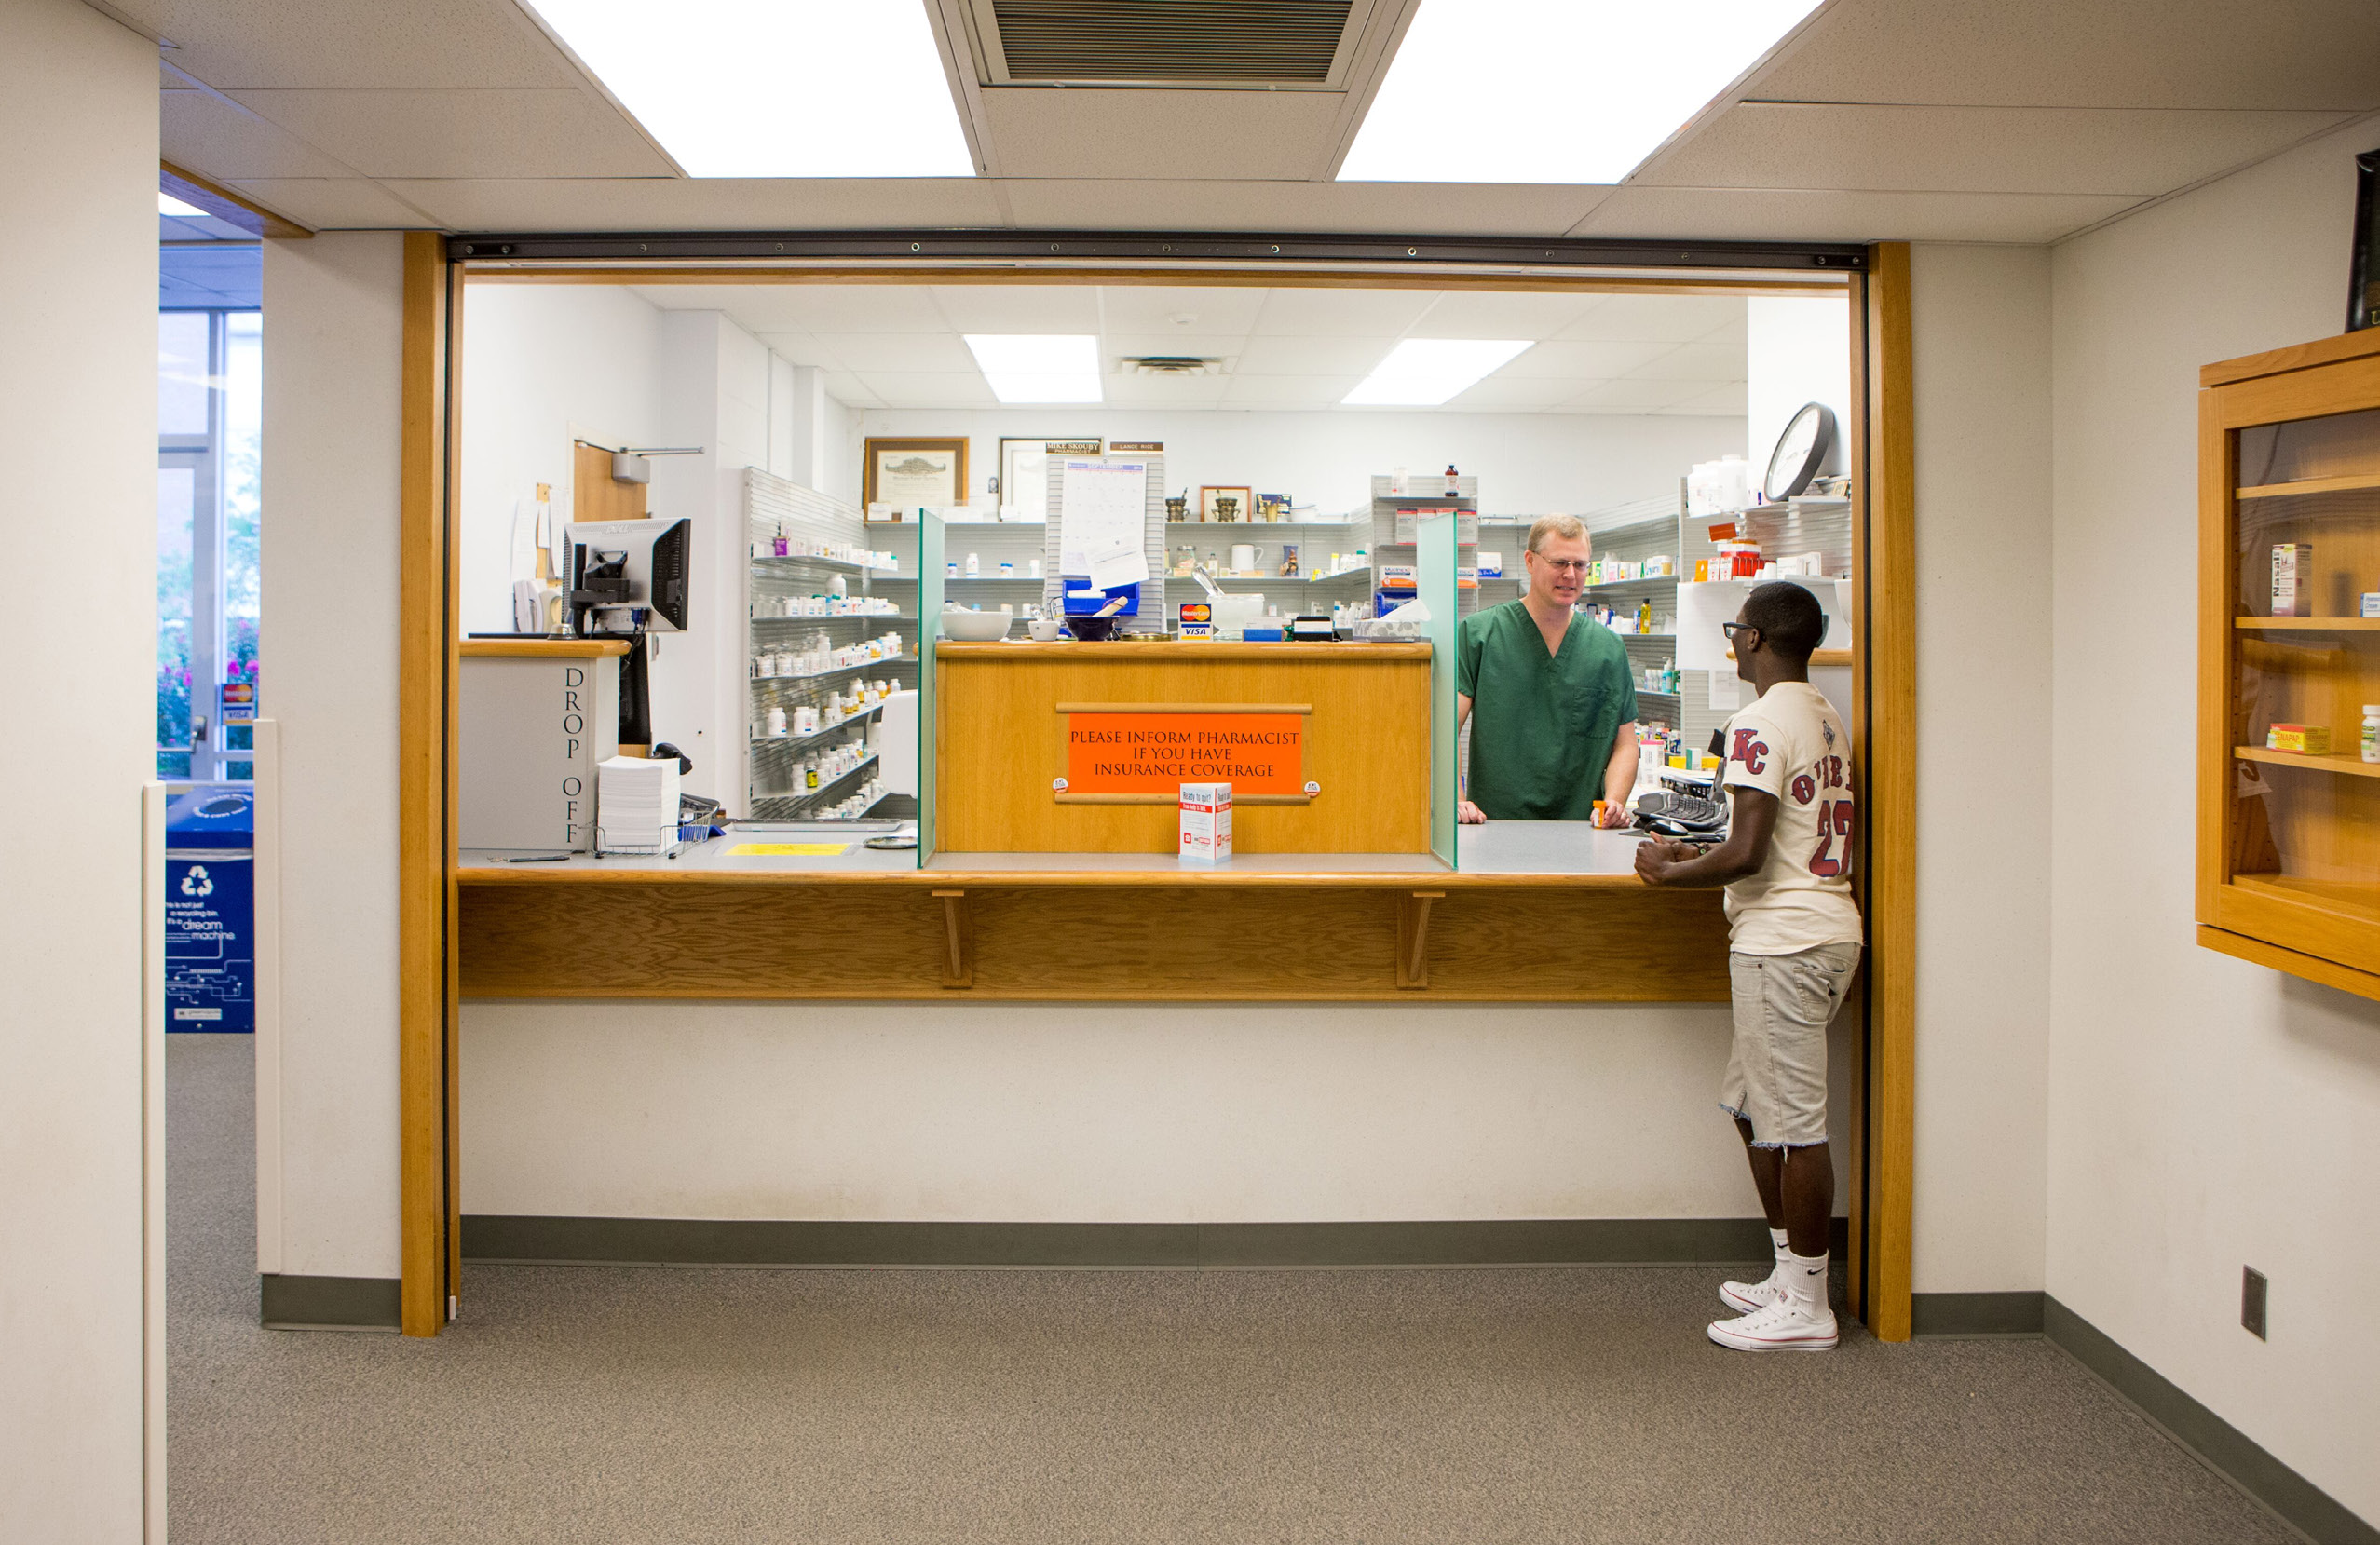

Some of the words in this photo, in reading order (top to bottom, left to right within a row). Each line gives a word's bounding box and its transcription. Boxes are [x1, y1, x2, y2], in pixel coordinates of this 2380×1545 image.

[1068, 442, 1099, 451] SKOUBY
[563, 667, 584, 759] DROP
[1071, 731, 1122, 744] PLEASE
[1127, 731, 1192, 744] INFORM
[1198, 731, 1299, 745] PHARMACIST
[1134, 747, 1147, 759] IF
[1151, 747, 1185, 760] YOU
[1191, 748, 1231, 760] HAVE
[1730, 728, 1769, 776] KC
[1095, 763, 1186, 777] INSURANCE
[1191, 764, 1274, 777] COVERAGE
[1183, 791, 1195, 801] Ready
[562, 777, 582, 844] OFF
[177, 910, 206, 918] recycling
[182, 919, 223, 930] dream
[191, 931, 236, 940] machine
